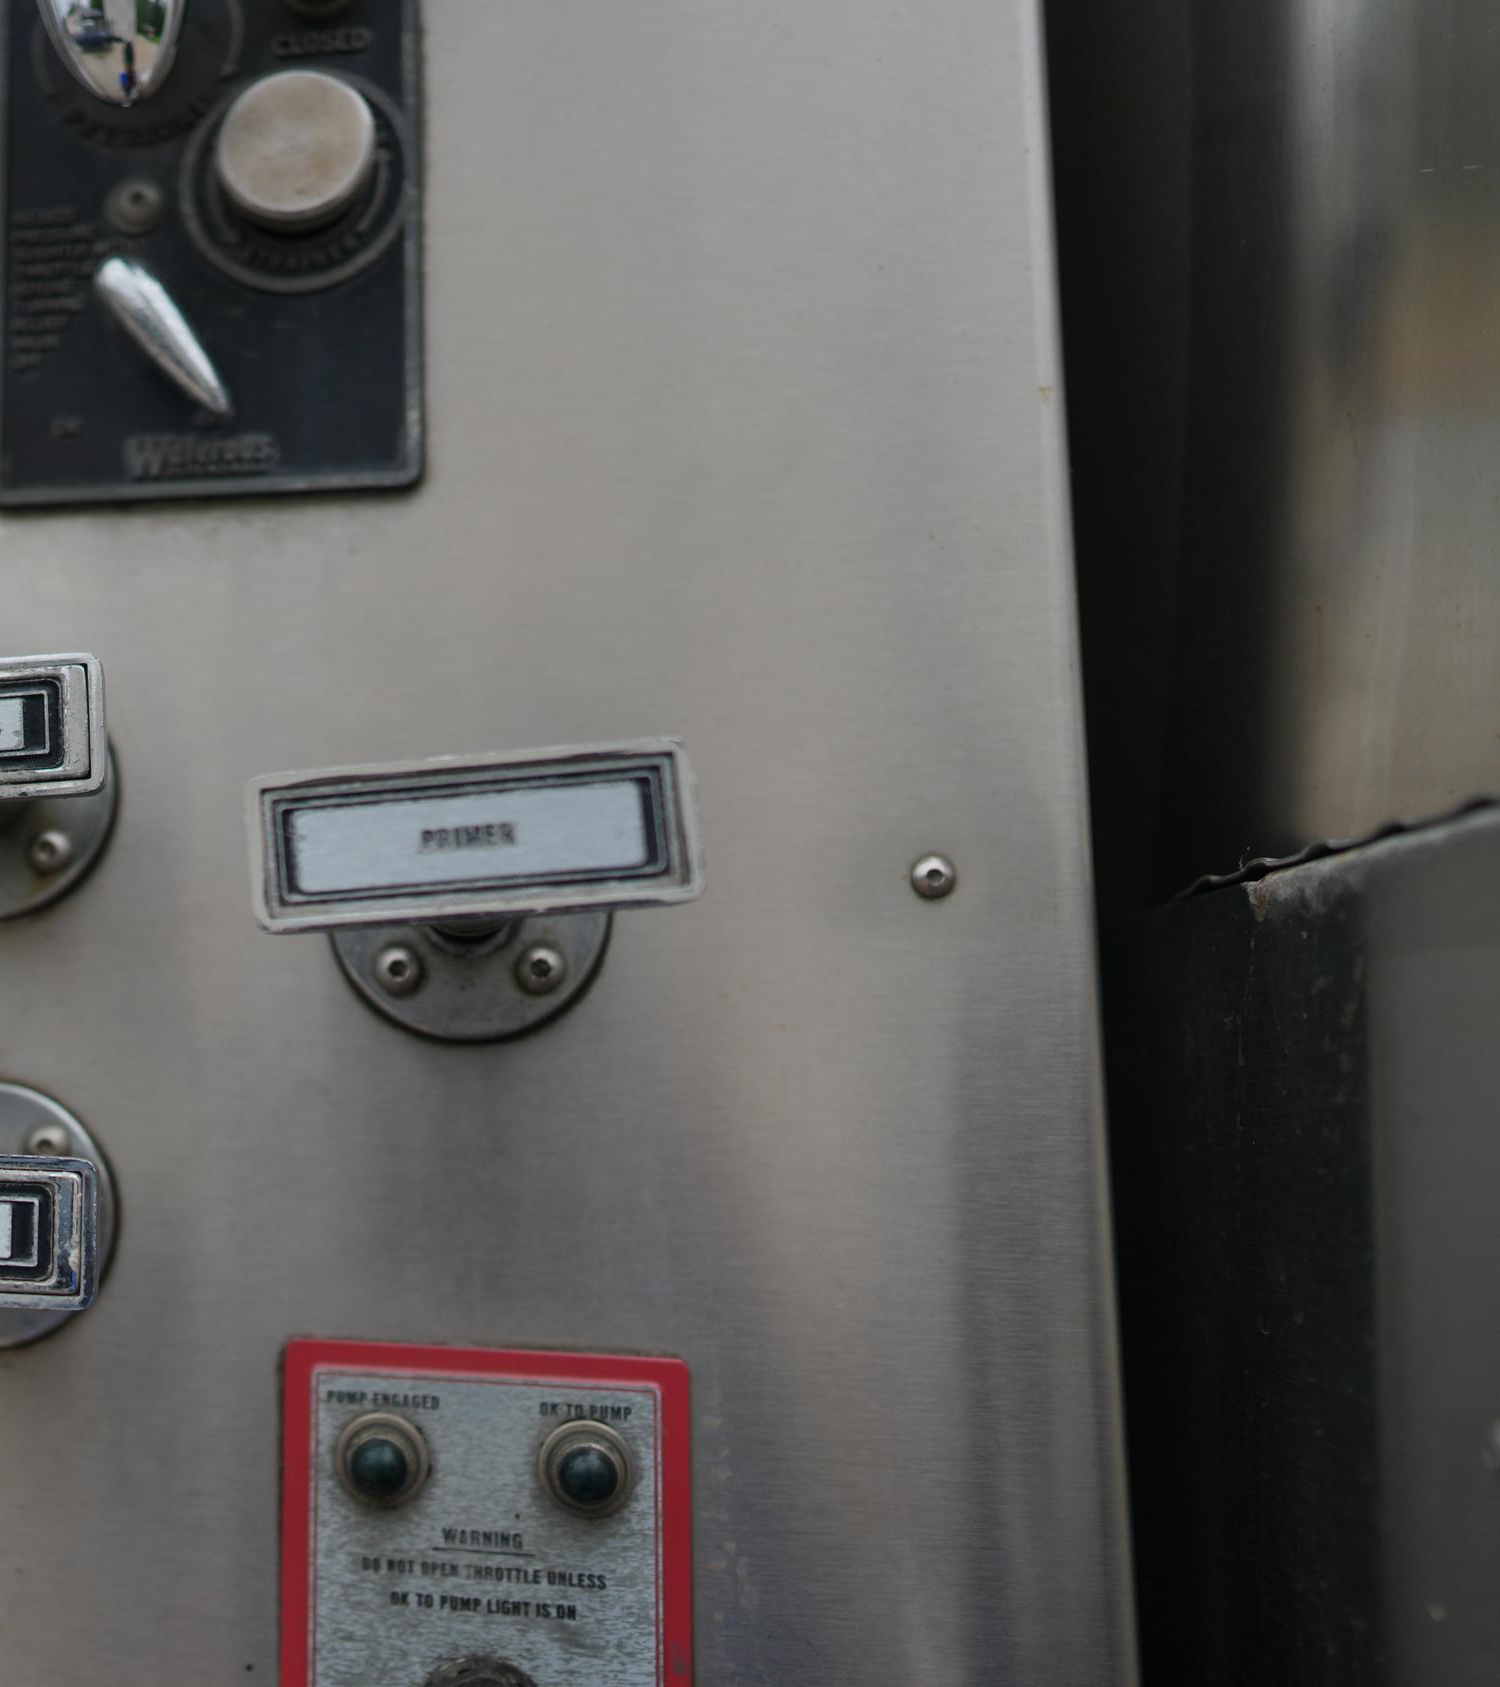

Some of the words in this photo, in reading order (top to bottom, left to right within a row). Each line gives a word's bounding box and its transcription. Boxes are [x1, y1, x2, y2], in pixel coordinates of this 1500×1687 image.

[273, 26, 373, 56] CLOSED
[420, 823, 517, 849] PRIMER
[326, 1390, 368, 1405] PUMP
[373, 1392, 440, 1410] ENGAGED
[540, 1402, 559, 1416] OK
[565, 1403, 584, 1418] TO
[589, 1405, 632, 1421] PUMP
[442, 1528, 523, 1549] WARNING
[362, 1556, 381, 1572] DO
[386, 1559, 414, 1574] NOT
[420, 1561, 459, 1577] OPEN
[464, 1564, 541, 1585] THROTTLE
[547, 1570, 607, 1590] UNLESS
[390, 1591, 409, 1607] OK
[415, 1593, 434, 1609] TO
[440, 1595, 482, 1614] PUMP
[487, 1598, 530, 1616] LIGHT
[536, 1602, 550, 1618] IS
[556, 1603, 577, 1620] ON
